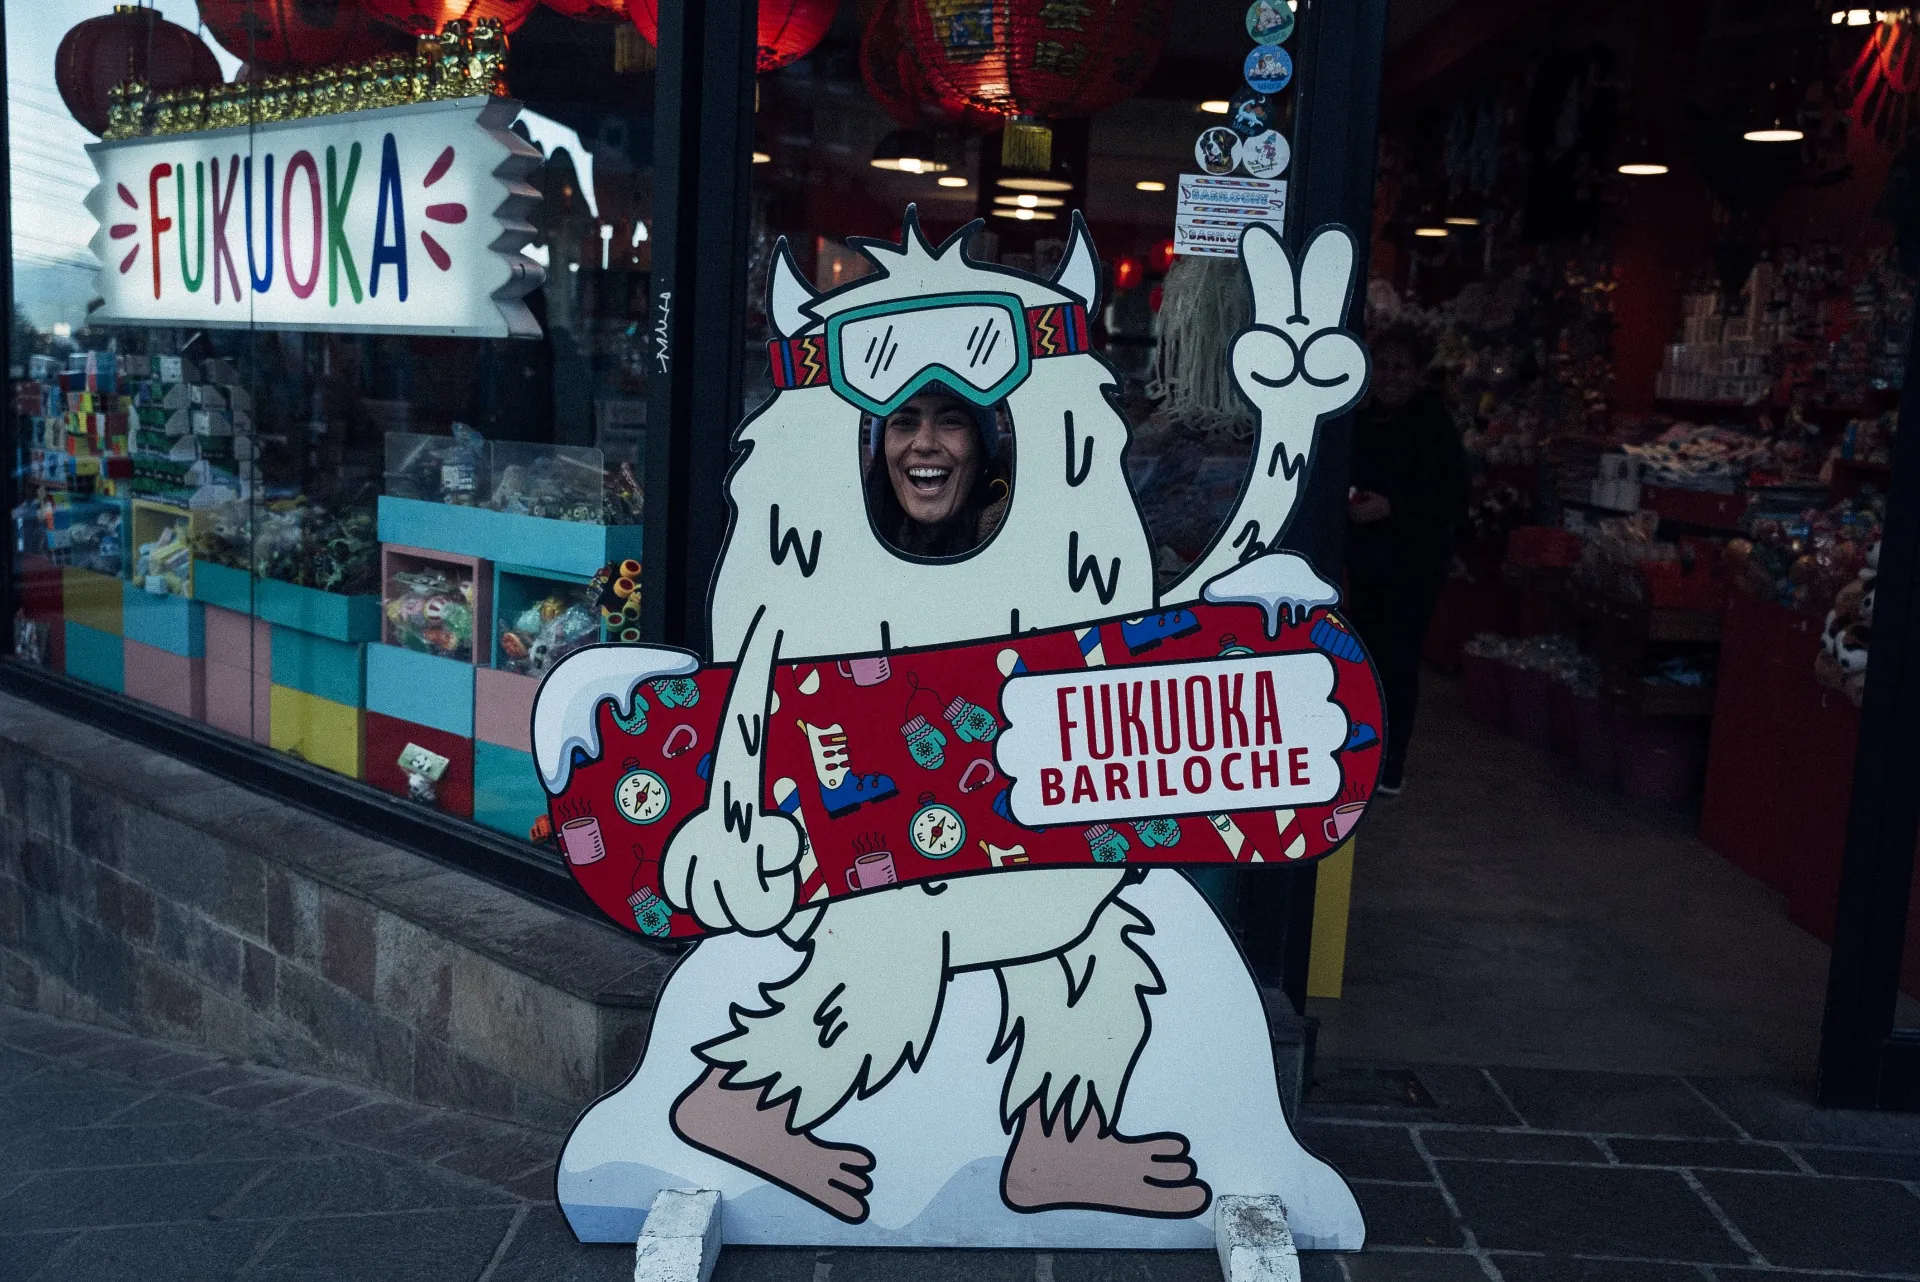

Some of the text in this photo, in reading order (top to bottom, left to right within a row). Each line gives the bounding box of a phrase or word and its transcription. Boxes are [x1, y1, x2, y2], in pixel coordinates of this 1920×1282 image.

[149, 132, 408, 307] FUKUOKA
[1188, 229, 1240, 243] BARILO
[1057, 670, 1282, 762] FUKUOKA
[1040, 747, 1310, 806] BARILOCHE
